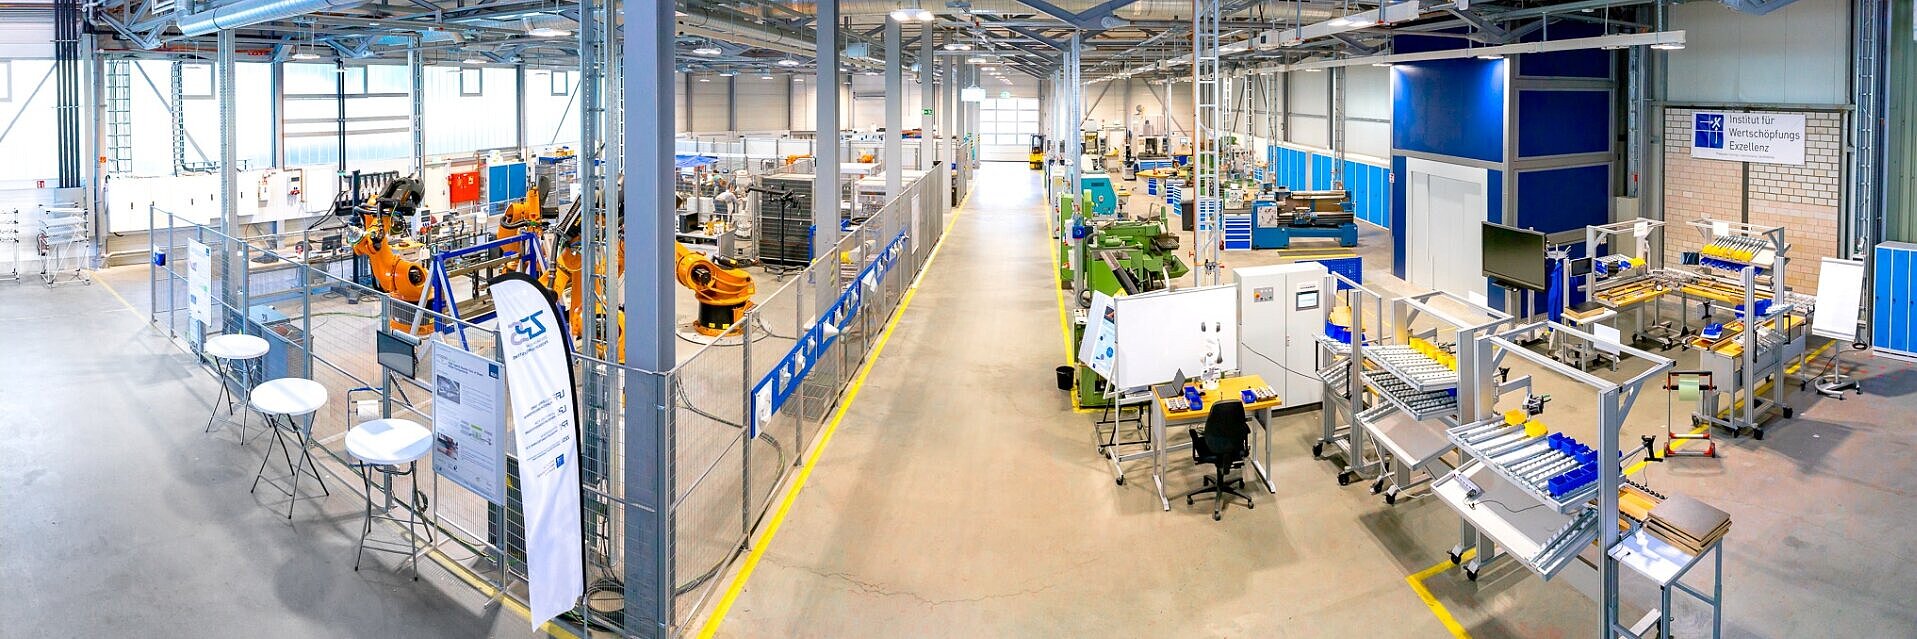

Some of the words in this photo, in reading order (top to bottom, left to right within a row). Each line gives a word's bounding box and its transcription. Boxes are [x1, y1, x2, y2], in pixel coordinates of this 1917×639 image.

[1729, 115, 1759, 125] Institut
[1761, 115, 1774, 125] für
[1728, 128, 1800, 141] Wertschöpfungs
[1729, 141, 1770, 152] Exzellenz
